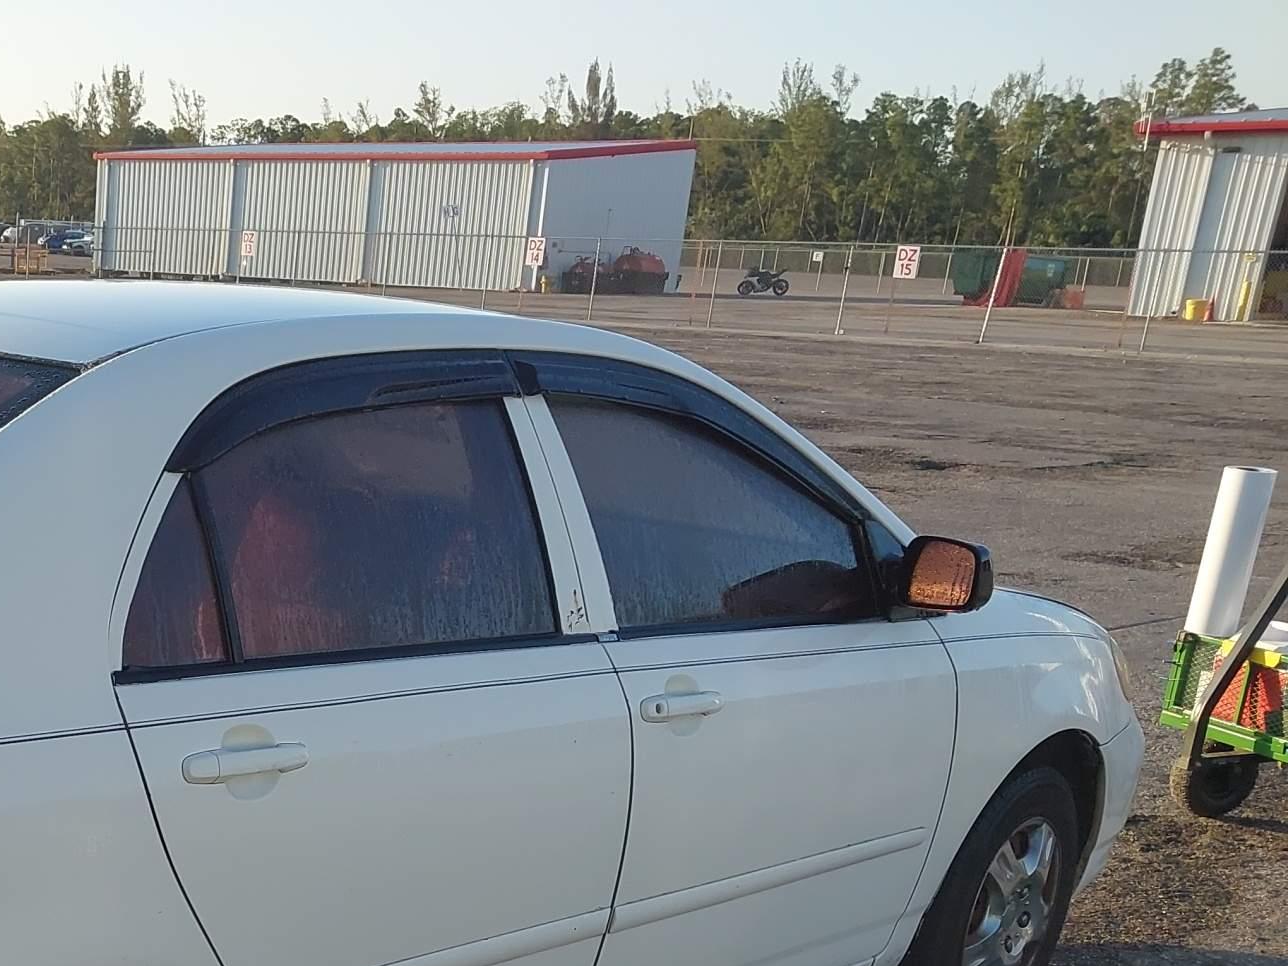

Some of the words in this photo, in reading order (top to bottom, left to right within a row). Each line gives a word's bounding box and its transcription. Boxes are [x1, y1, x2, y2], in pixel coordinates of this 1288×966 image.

[244, 233, 255, 243] DZ
[245, 243, 252, 254] 13
[529, 239, 544, 251] DZ
[531, 252, 540, 263] 14
[898, 248, 918, 262] DZ
[900, 264, 912, 276] 15
